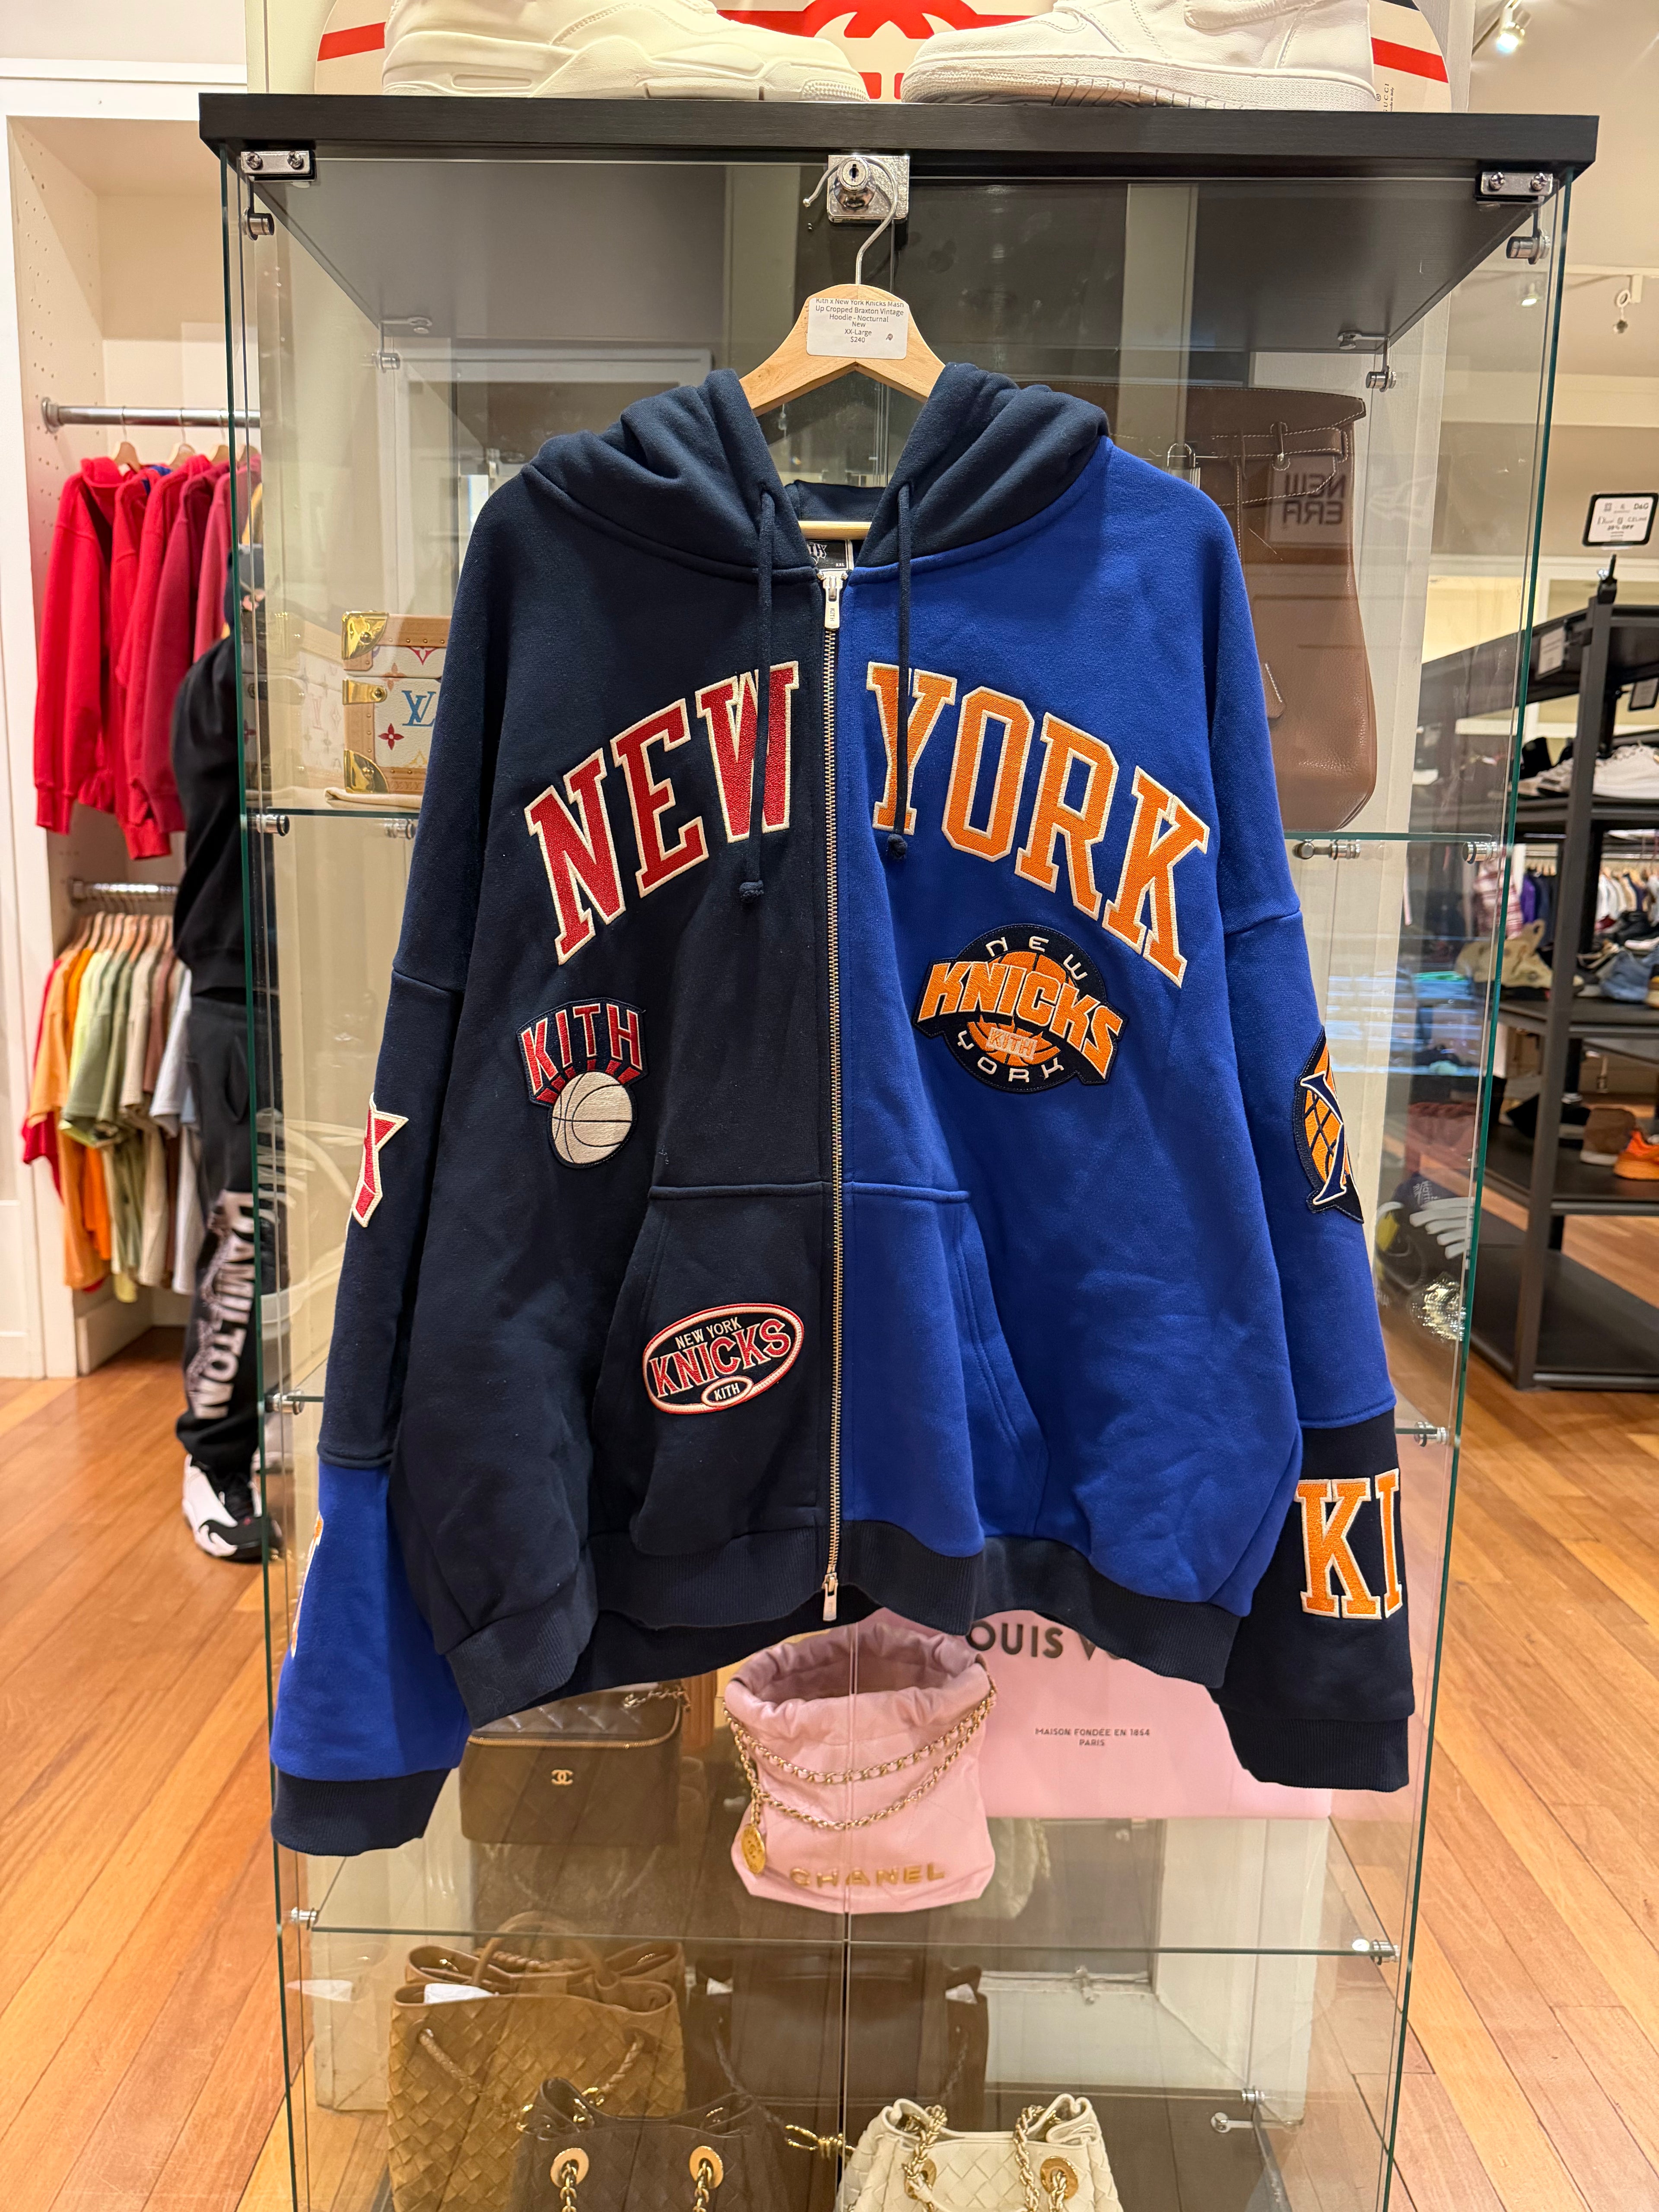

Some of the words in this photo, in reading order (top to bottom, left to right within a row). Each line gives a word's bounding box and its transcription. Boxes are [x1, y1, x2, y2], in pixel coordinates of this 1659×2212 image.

[880, 308, 904, 317] Vintage
[524, 661, 799, 965] NEW
[866, 661, 1210, 988] YORK
[985, 936, 1087, 981] NEW
[917, 961, 1123, 1080] KNICKS
[521, 1003, 642, 1095] KITH
[958, 1030, 1064, 1082] YORK
[988, 1029, 1037, 1058] KITH
[675, 1328, 704, 1349] NEW
[706, 1316, 742, 1338] YORK
[649, 1319, 791, 1398] KNICKS
[714, 1382, 741, 1401] KITH
[966, 1621, 1063, 1658] OUIS
[790, 1862, 945, 1888] CHANEL
